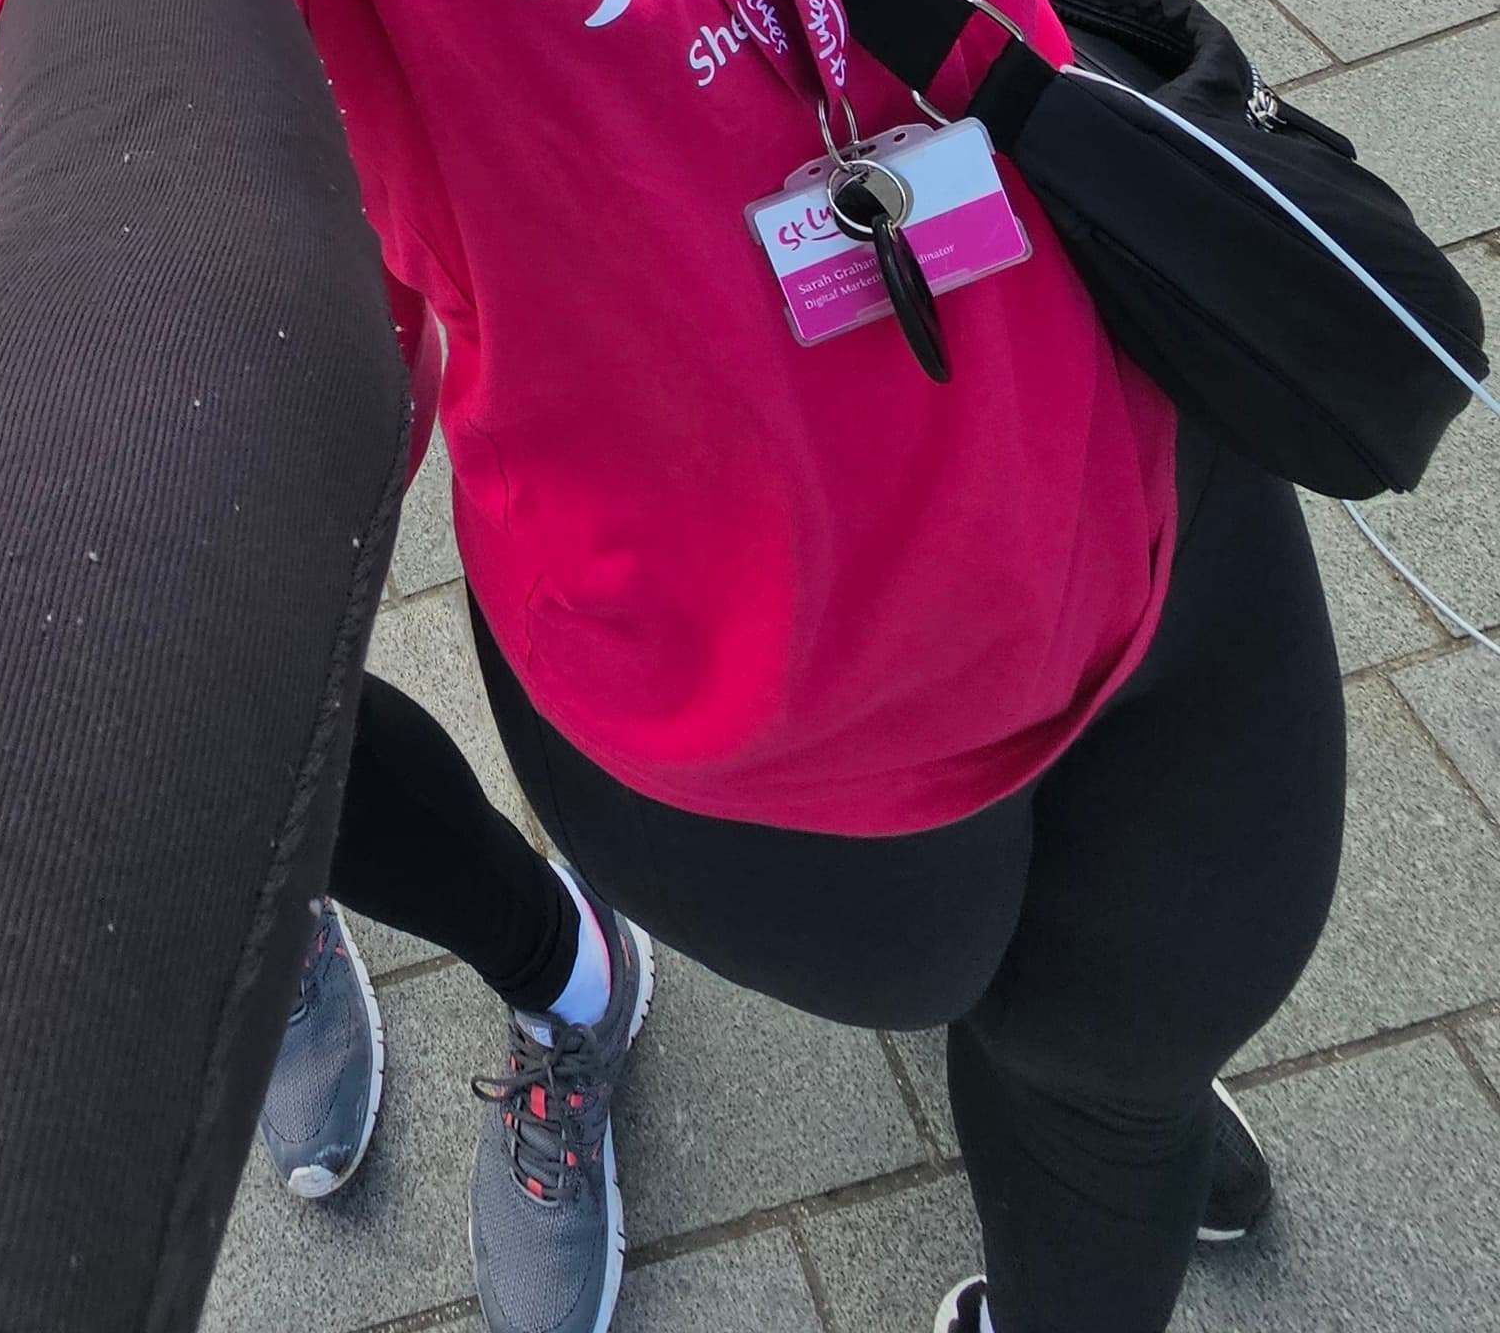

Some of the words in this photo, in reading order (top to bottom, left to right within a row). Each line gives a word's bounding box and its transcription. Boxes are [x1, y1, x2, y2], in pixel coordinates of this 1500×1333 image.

[830, 51, 847, 87] St
[797, 274, 832, 295] Sarah
[804, 289, 839, 310] Digital
[840, 273, 884, 295] Marketi
